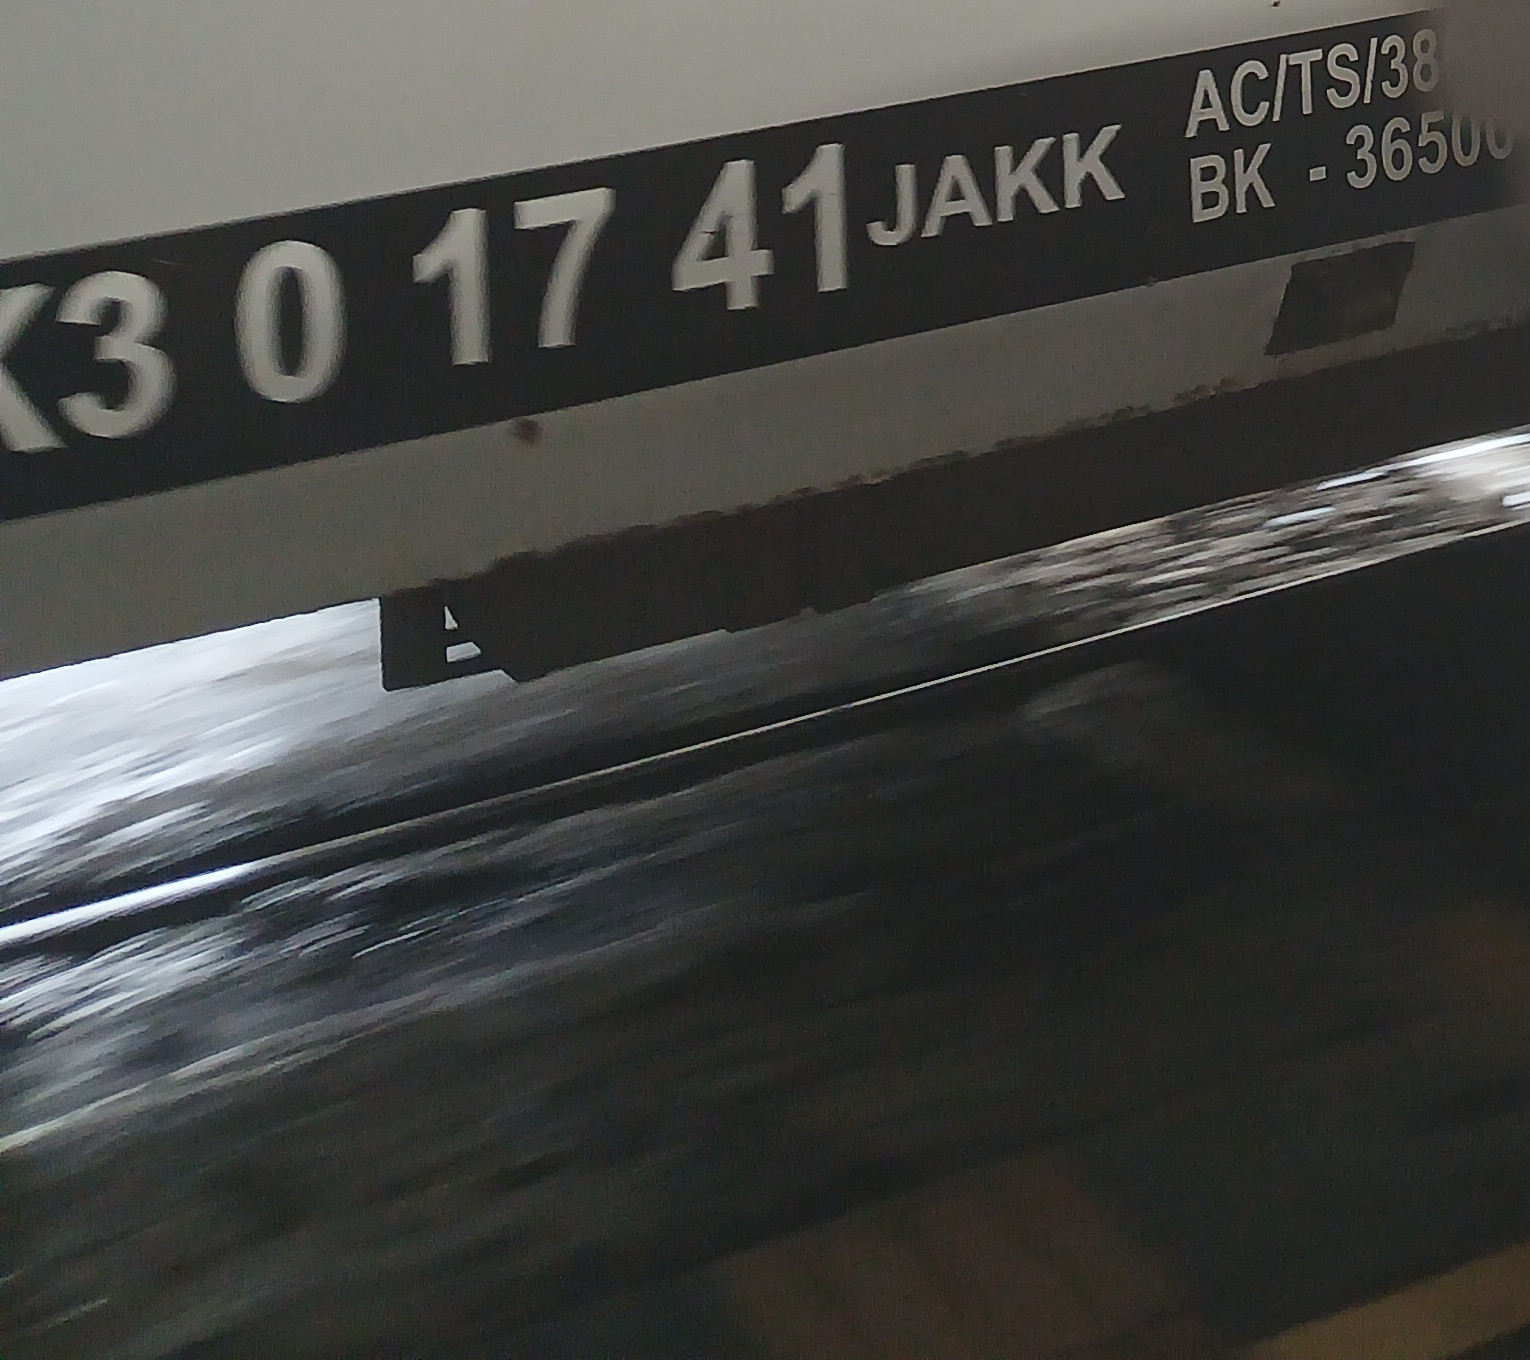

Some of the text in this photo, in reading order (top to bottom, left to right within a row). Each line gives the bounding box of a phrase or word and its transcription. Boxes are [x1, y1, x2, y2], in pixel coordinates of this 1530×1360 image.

[235, 240, 348, 404] 0
[412, 186, 617, 366] 17
[671, 142, 849, 311] 41
[866, 123, 1126, 247] JAKK
[1188, 142, 1276, 223] BK
